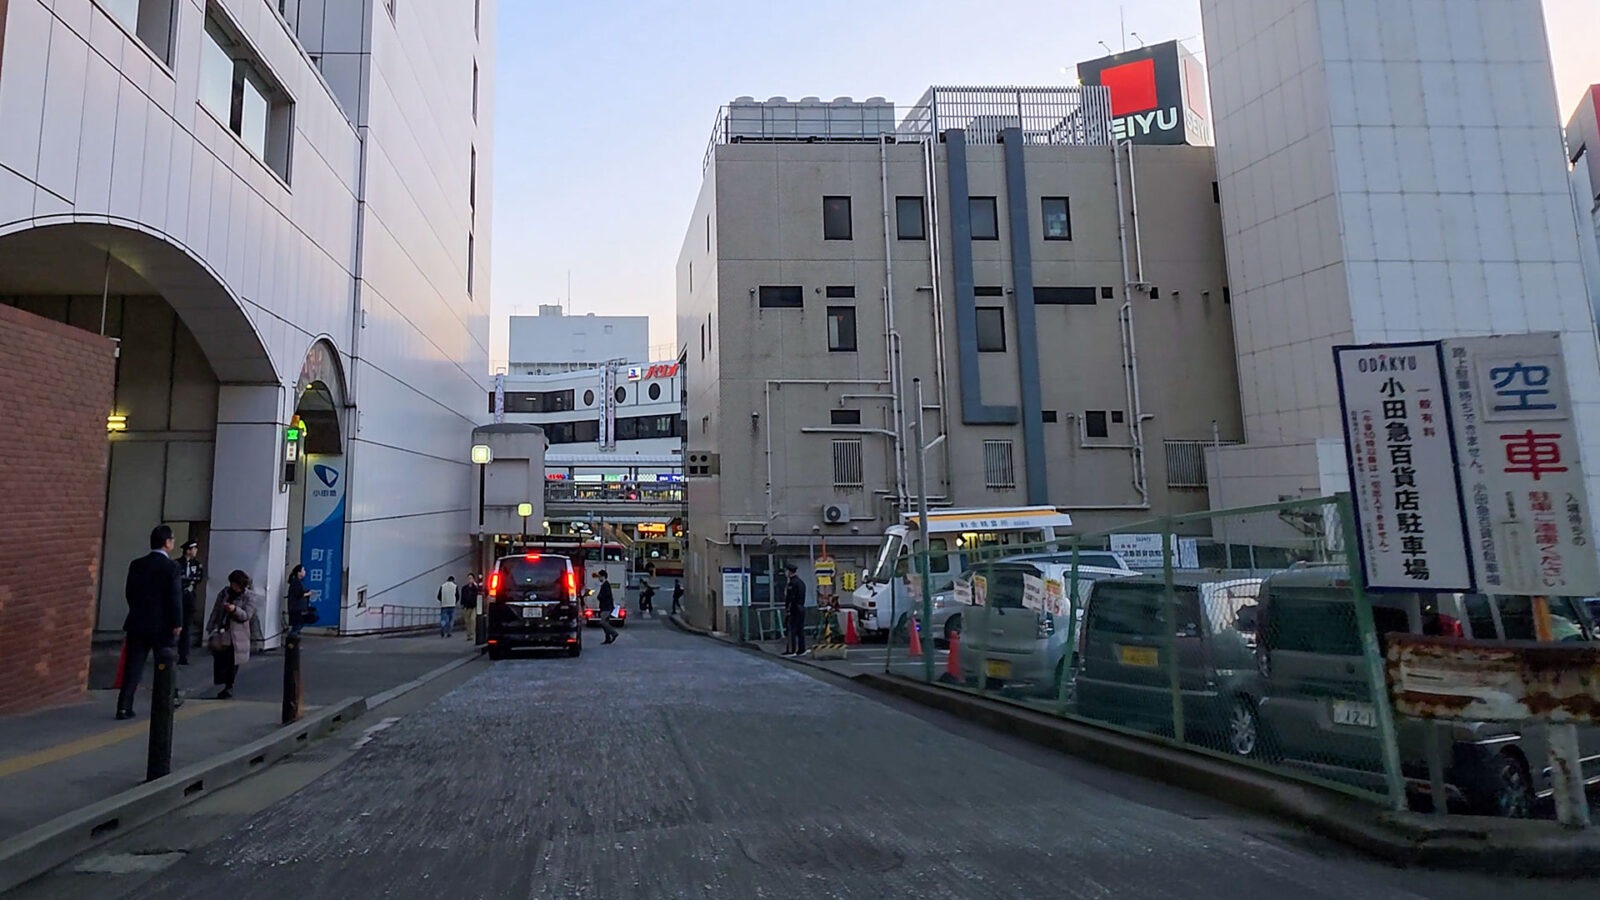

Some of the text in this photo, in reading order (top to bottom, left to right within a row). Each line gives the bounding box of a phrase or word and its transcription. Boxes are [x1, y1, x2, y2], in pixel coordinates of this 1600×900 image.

[1110, 107, 1178, 140] EIYU
[1358, 355, 1417, 373] ODAKYU
[1379, 377, 1430, 581] 小田急百貨店駐車場
